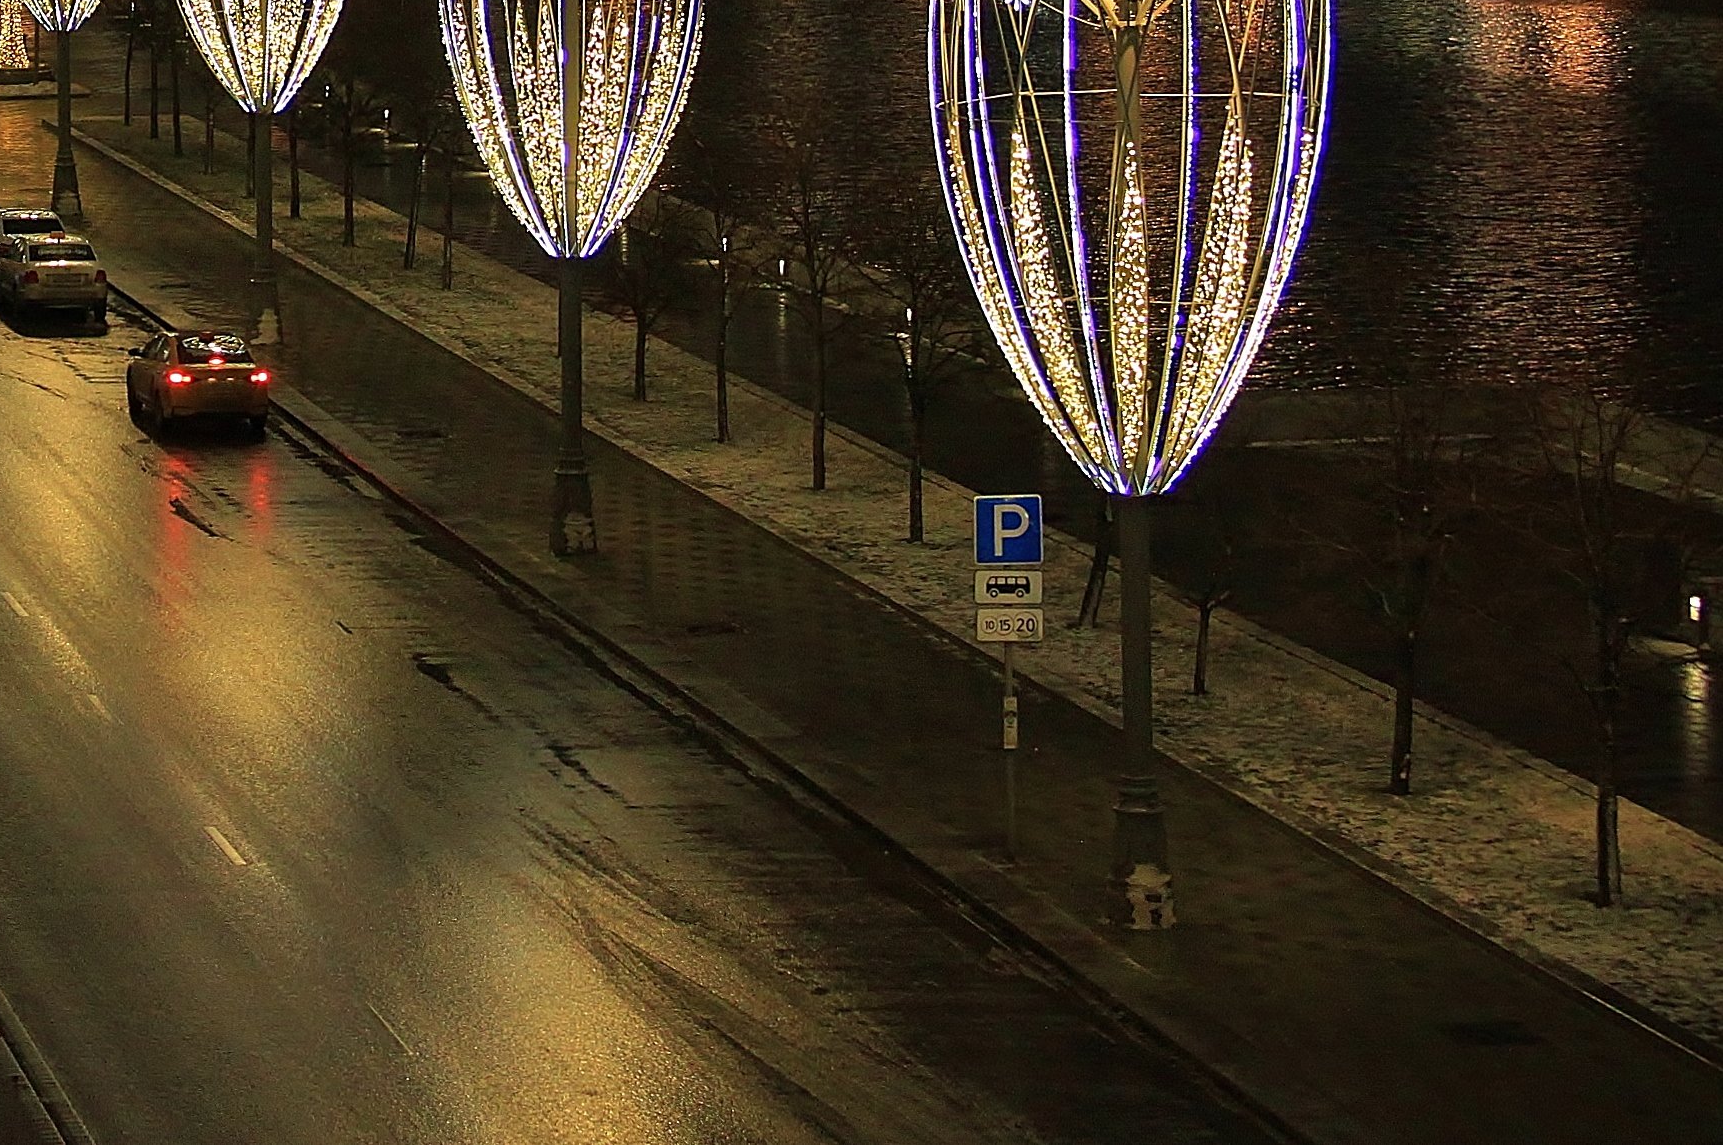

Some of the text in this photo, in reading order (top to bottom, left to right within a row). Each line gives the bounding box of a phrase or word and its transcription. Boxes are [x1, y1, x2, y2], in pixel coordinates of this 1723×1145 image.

[994, 503, 1030, 557] P
[984, 618, 1035, 632] 10 15 20
